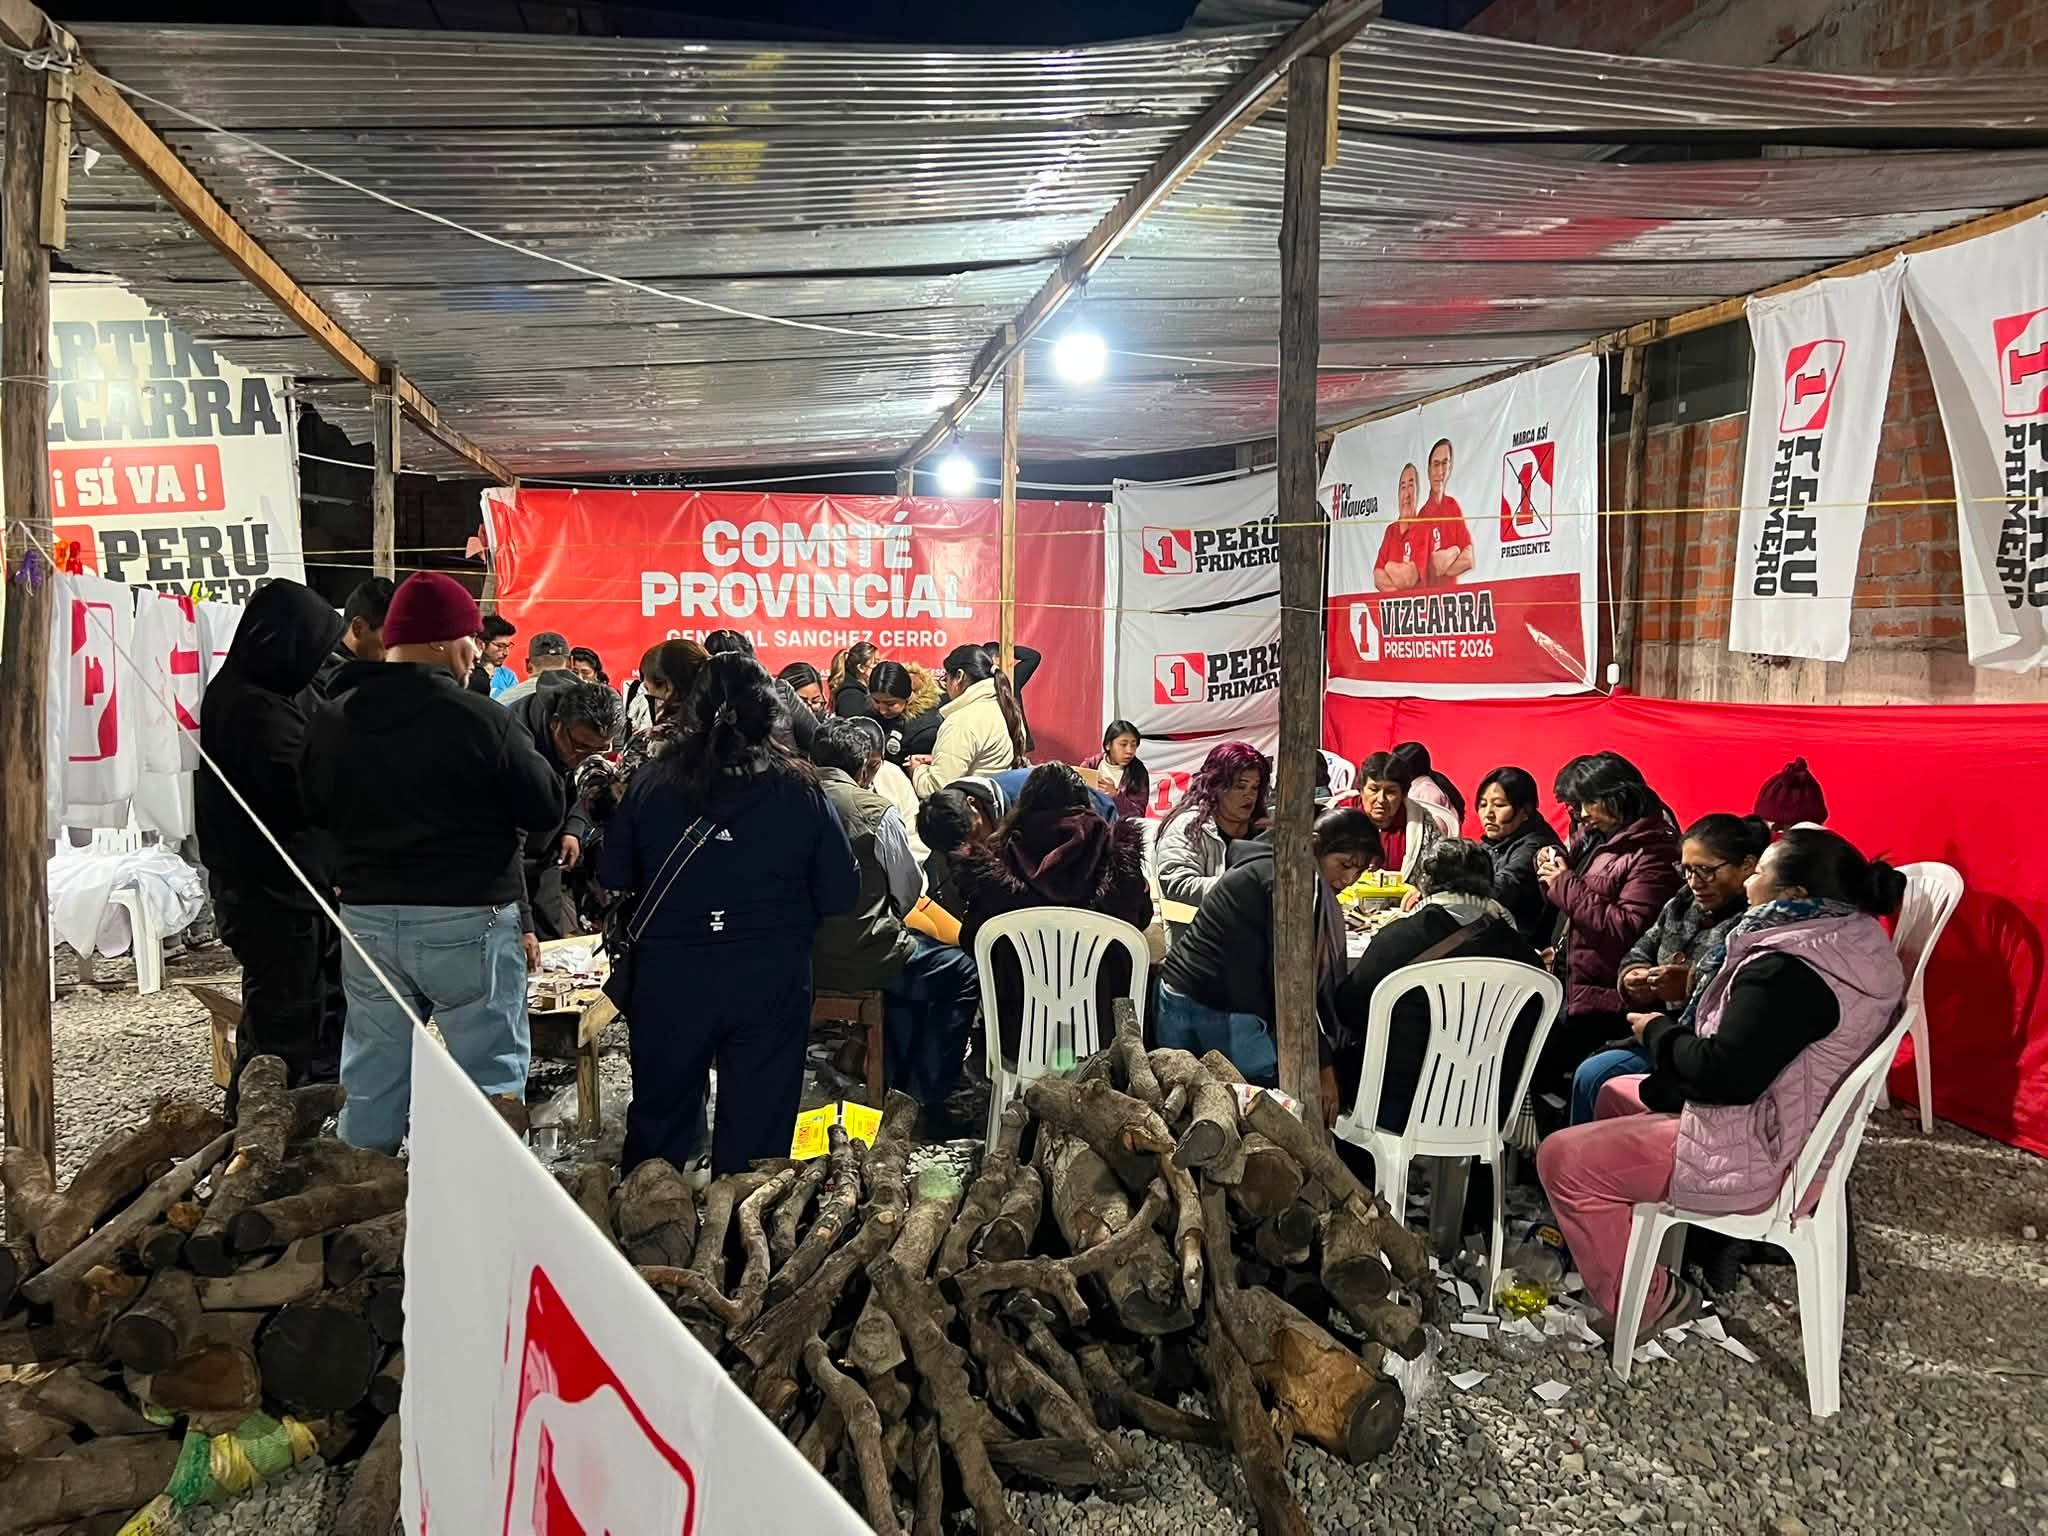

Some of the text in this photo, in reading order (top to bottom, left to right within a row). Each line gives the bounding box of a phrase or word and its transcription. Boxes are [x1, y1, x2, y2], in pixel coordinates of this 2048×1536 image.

[1512, 422, 1549, 447] MARCA ASÍ
[75, 456, 118, 507] SÍ
[126, 464, 185, 503] VA
[195, 463, 207, 502] !
[99, 516, 270, 582] PERÚ
[702, 510, 913, 569] COMITÉ
[1158, 513, 1280, 569] 1 PERÚ
[1500, 541, 1551, 559] PRESIDENTE
[1195, 546, 1280, 573] PRIMERO
[641, 571, 973, 619] PROVINCIAL
[879, 630, 947, 648] CERRO
[1358, 591, 1496, 653] 1 VIZCARRA
[1384, 638, 1494, 658] PRESIDENTE 2026
[1170, 662, 1190, 697] 1
[1207, 671, 1280, 702] PRIMER
